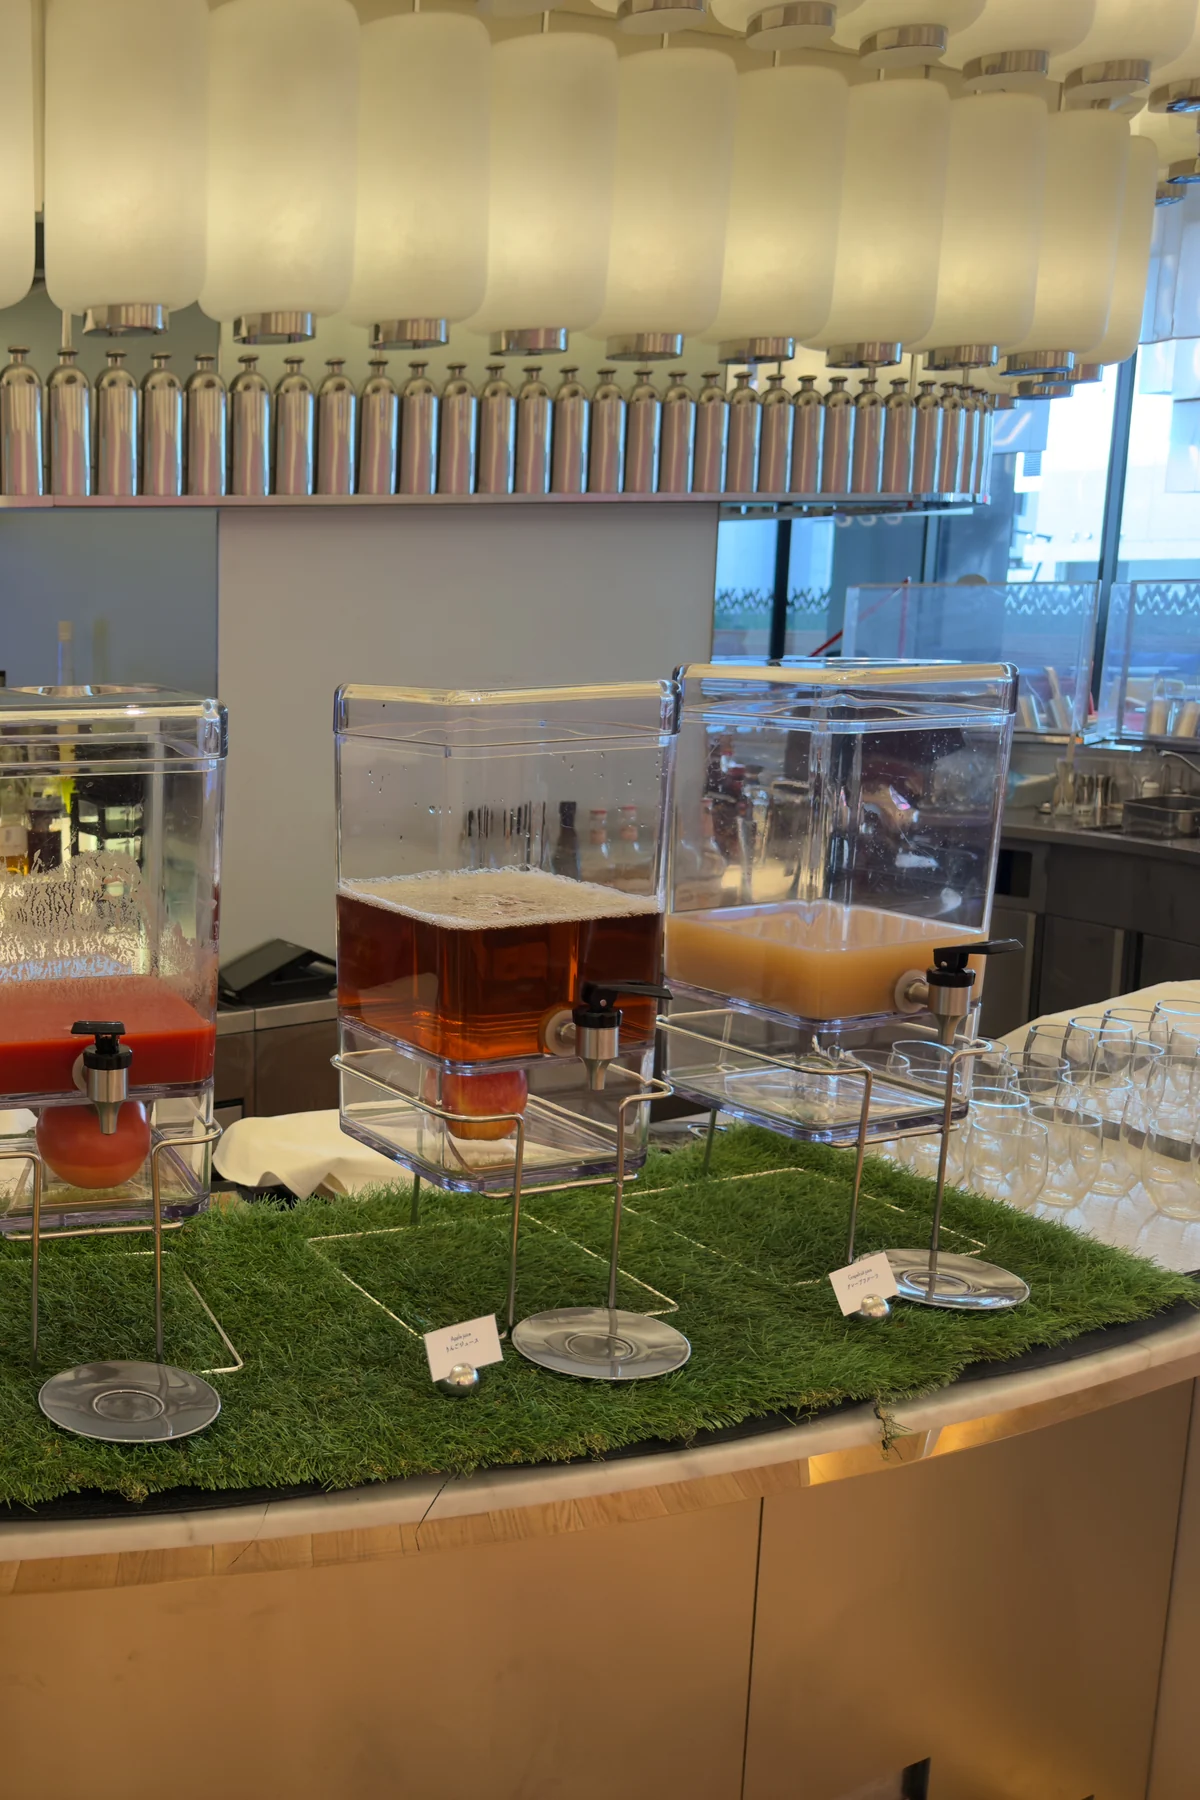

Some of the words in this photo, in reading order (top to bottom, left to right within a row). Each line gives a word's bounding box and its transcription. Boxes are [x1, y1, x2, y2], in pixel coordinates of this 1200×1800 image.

[445, 1338, 480, 1353] りんごジュース
